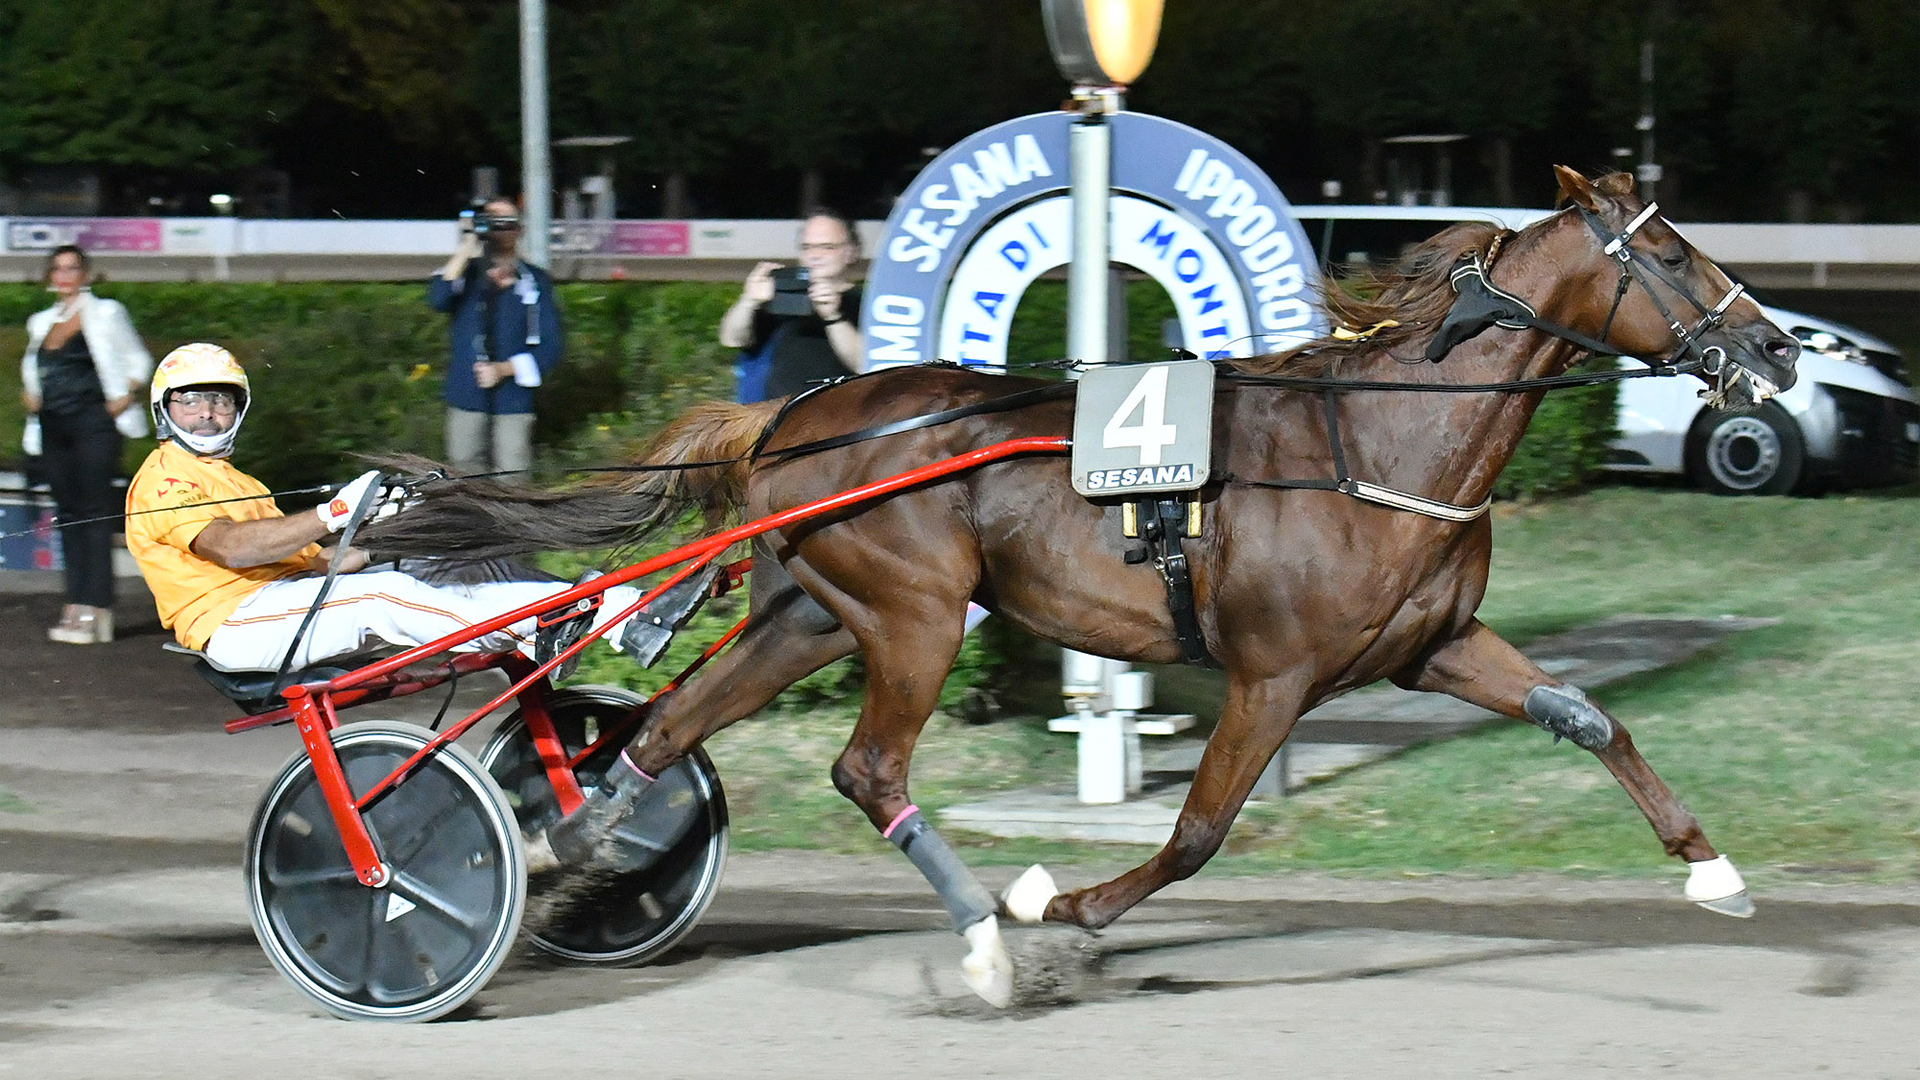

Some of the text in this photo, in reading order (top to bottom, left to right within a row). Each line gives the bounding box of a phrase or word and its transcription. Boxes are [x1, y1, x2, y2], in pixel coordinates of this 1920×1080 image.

[888, 134, 1053, 273] SESANA
[1000, 221, 1050, 272] DI
[1103, 366, 1177, 465] 4
[1088, 465, 1192, 489] SESANA
[331, 501, 347, 513] AG
